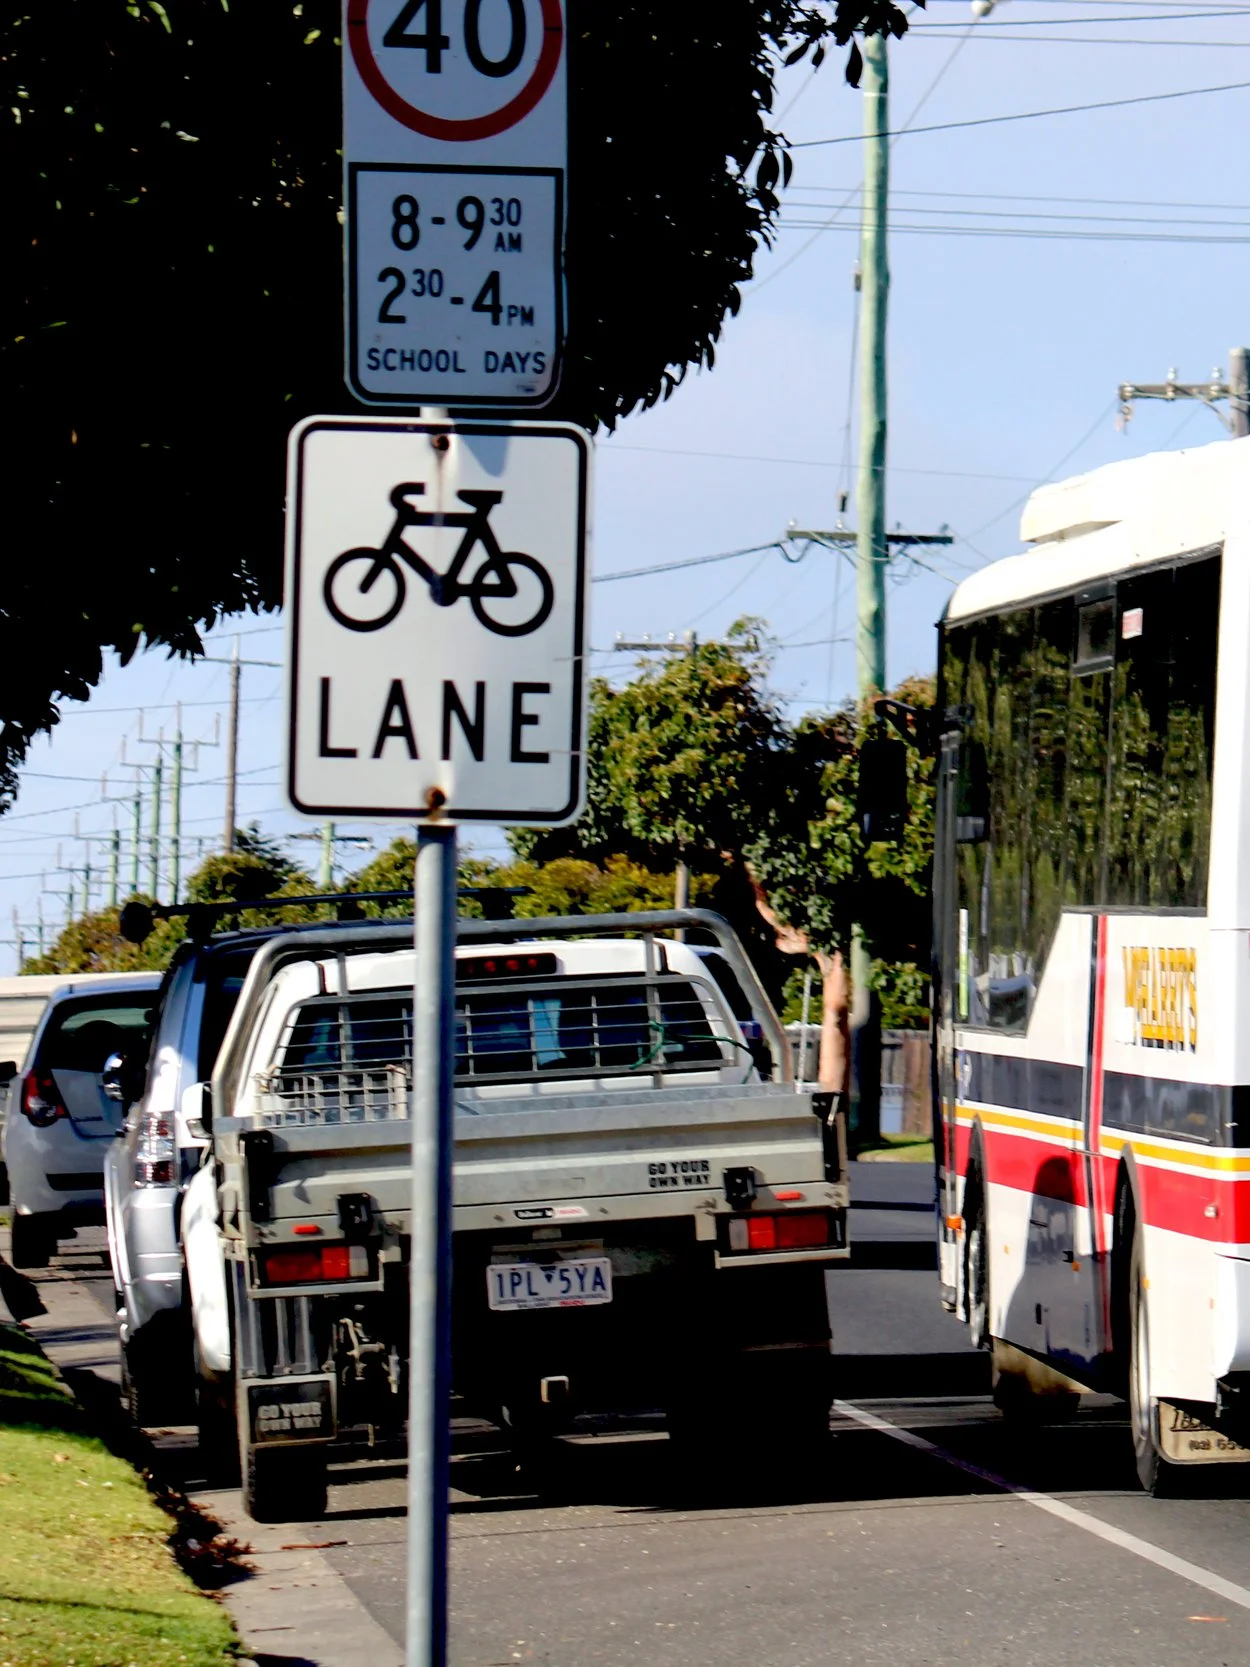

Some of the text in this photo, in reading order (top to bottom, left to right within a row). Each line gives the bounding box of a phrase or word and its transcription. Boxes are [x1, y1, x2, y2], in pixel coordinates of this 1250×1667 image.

[383, 0, 527, 78] 40
[494, 232, 522, 253] AM
[507, 305, 534, 327] PM
[366, 348, 546, 375] SCHOOL DAYS
[318, 677, 551, 764] LANE
[649, 1160, 710, 1176] GO YOUR
[650, 1174, 711, 1188] OWN WAY
[558, 1266, 607, 1294] 5YA
